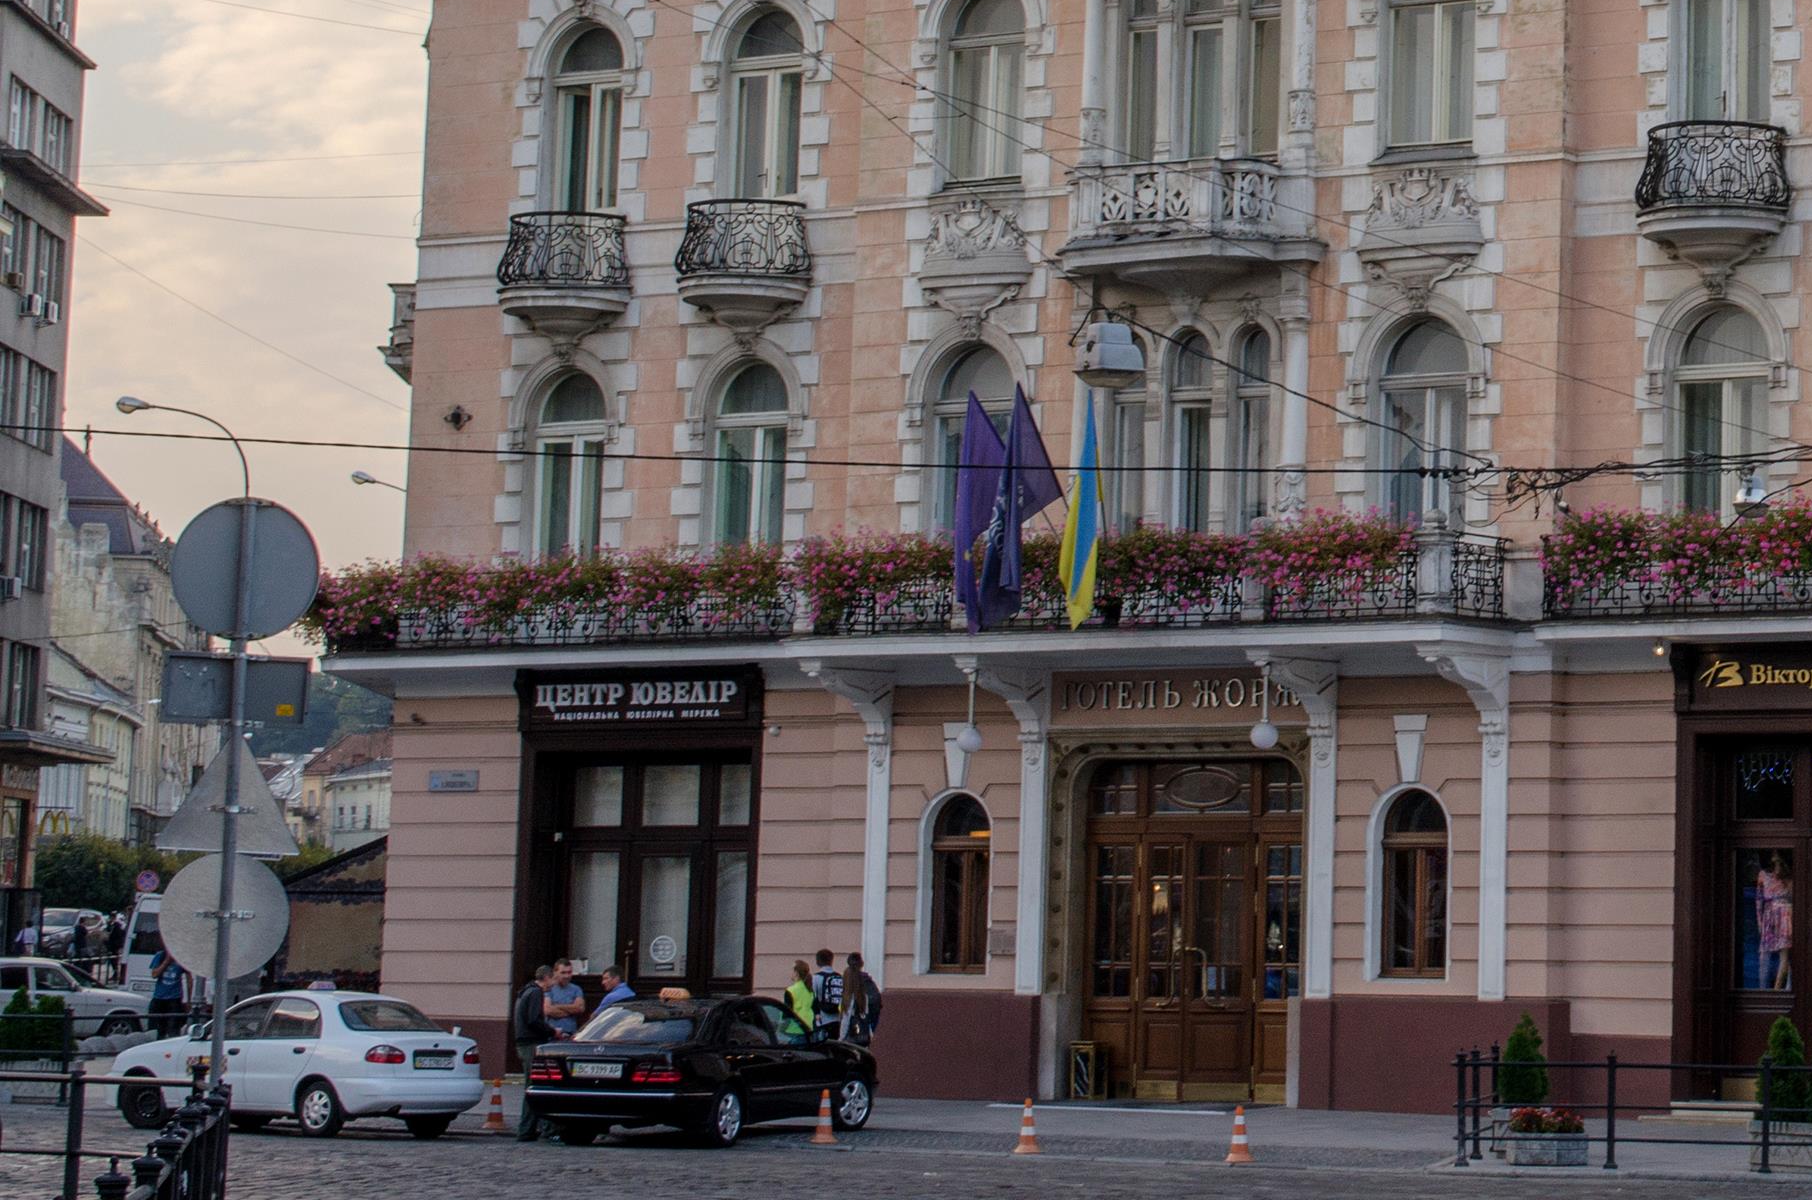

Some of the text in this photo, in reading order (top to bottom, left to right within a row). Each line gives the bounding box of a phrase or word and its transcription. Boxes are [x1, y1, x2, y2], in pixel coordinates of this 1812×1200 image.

[535, 679, 738, 712] ЦЕНТР ЮВЕЛІР
[1060, 680, 1181, 711] ГОТЕЛЬ
[554, 708, 720, 721] НАЦІОНАЛЬНА ЮВЕЛІРНА МЕРЕЖА
